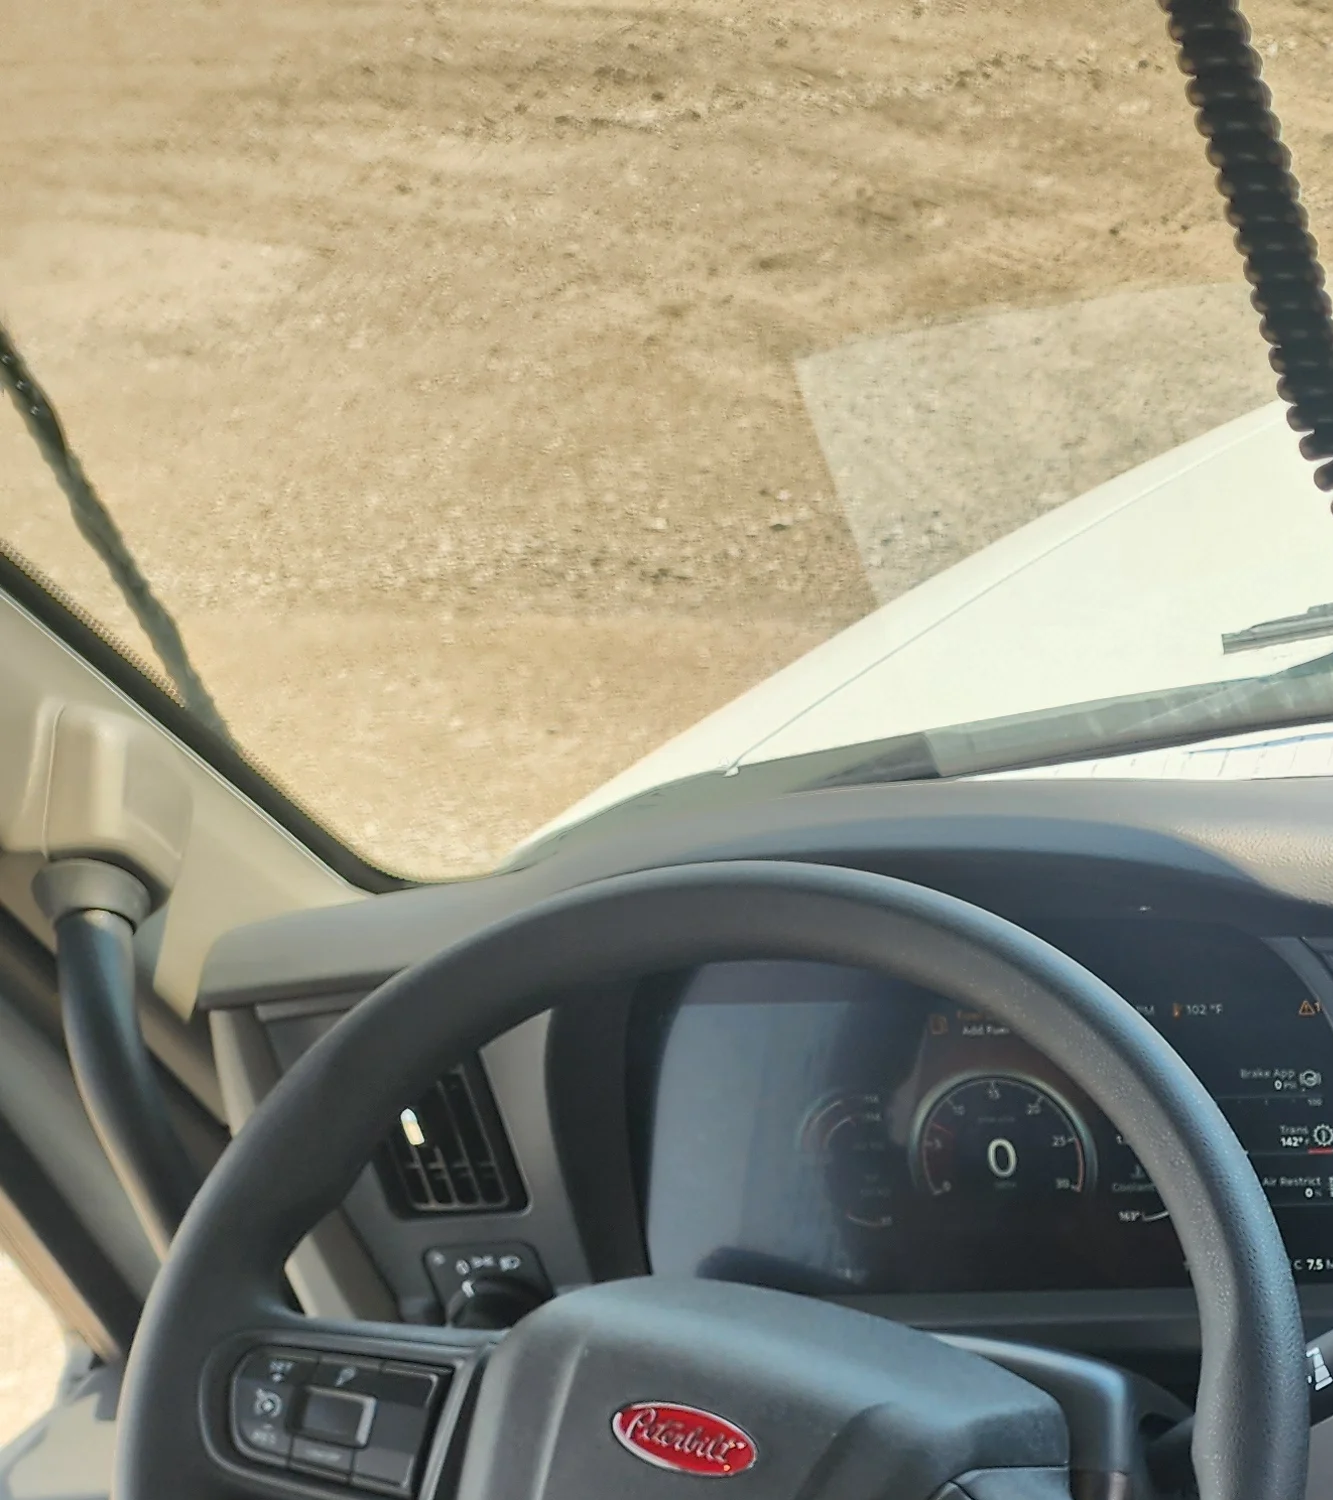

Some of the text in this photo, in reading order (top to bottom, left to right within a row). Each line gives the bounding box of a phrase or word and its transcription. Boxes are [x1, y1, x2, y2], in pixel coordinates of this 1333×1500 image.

[1186, 1005, 1207, 1016] 102
[962, 1026, 985, 1036] Add
[1240, 1069, 1295, 1080] Brake App
[1274, 1081, 1282, 1090] 0
[1280, 1125, 1309, 1134] Trans
[988, 1138, 1017, 1178] 0
[1263, 1176, 1321, 1187] Air Restrict
[1304, 1188, 1314, 1198] 0
[1306, 1259, 1324, 1270] 7.5
[625, 1408, 746, 1464] Peterbilt
